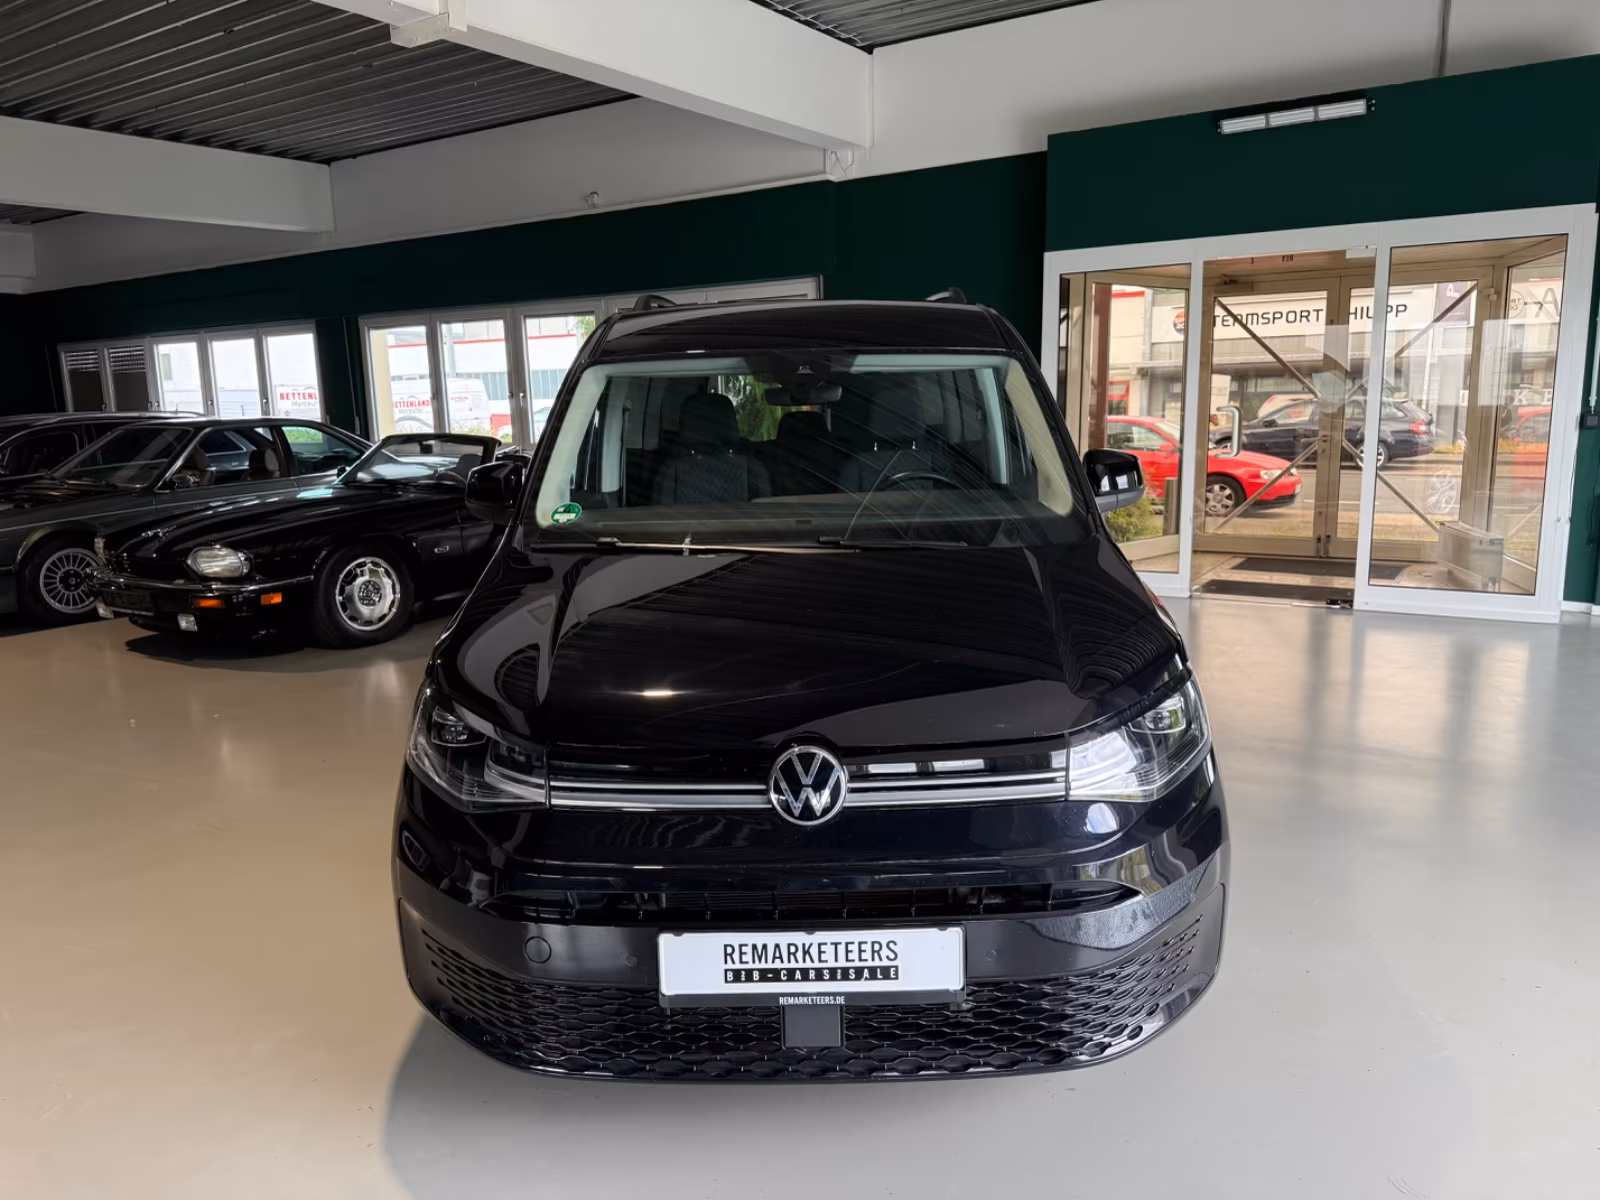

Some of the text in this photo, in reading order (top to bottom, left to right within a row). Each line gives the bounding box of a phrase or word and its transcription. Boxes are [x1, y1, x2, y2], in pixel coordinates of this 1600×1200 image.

[1213, 303, 1408, 328] TEAMSPORT HILPP
[279, 391, 318, 401] BETTENL
[723, 939, 898, 965] REMARKETEERS
[779, 995, 846, 1005] REMARKETEERS.DE
